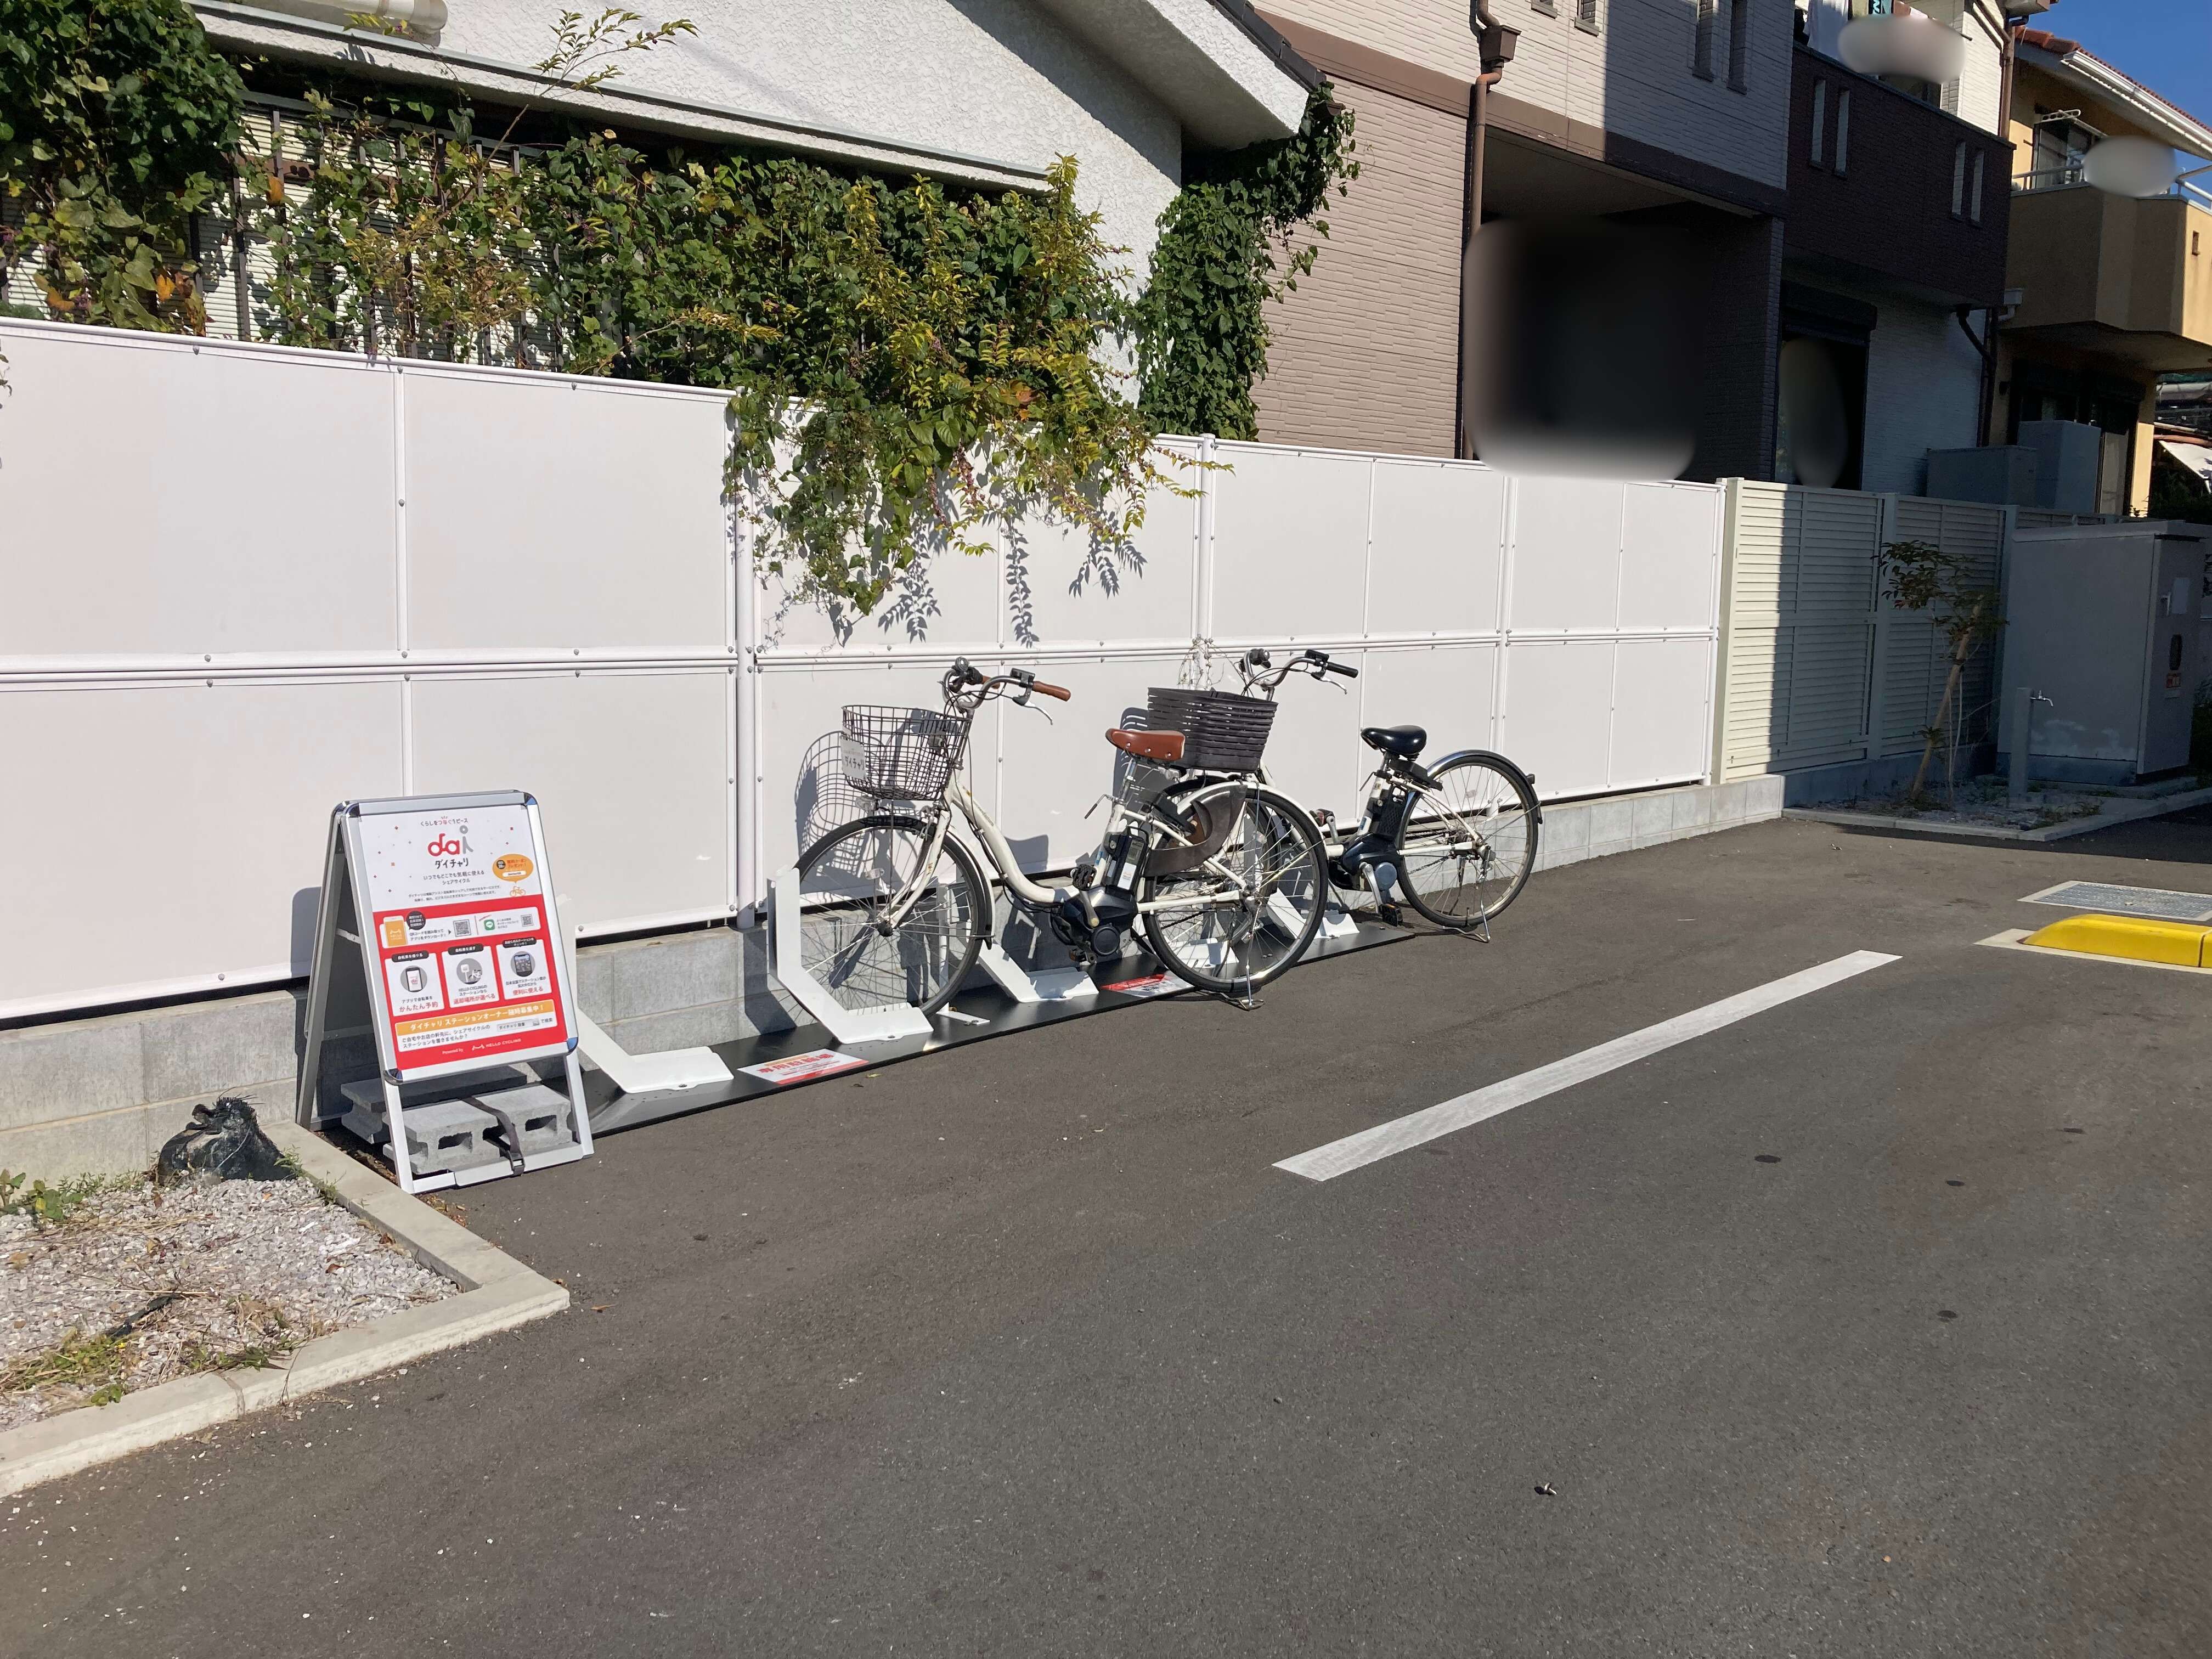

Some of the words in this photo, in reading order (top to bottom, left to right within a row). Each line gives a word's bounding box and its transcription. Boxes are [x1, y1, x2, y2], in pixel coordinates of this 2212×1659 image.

[435, 858, 469, 869] ダイチャリ
[423, 870, 484, 880] いつでもどこでも気軽に使える
[513, 987, 543, 995] 便利に使える
[399, 1001, 438, 1012] かんたん予約
[411, 1020, 443, 1031] ダイチャリ
